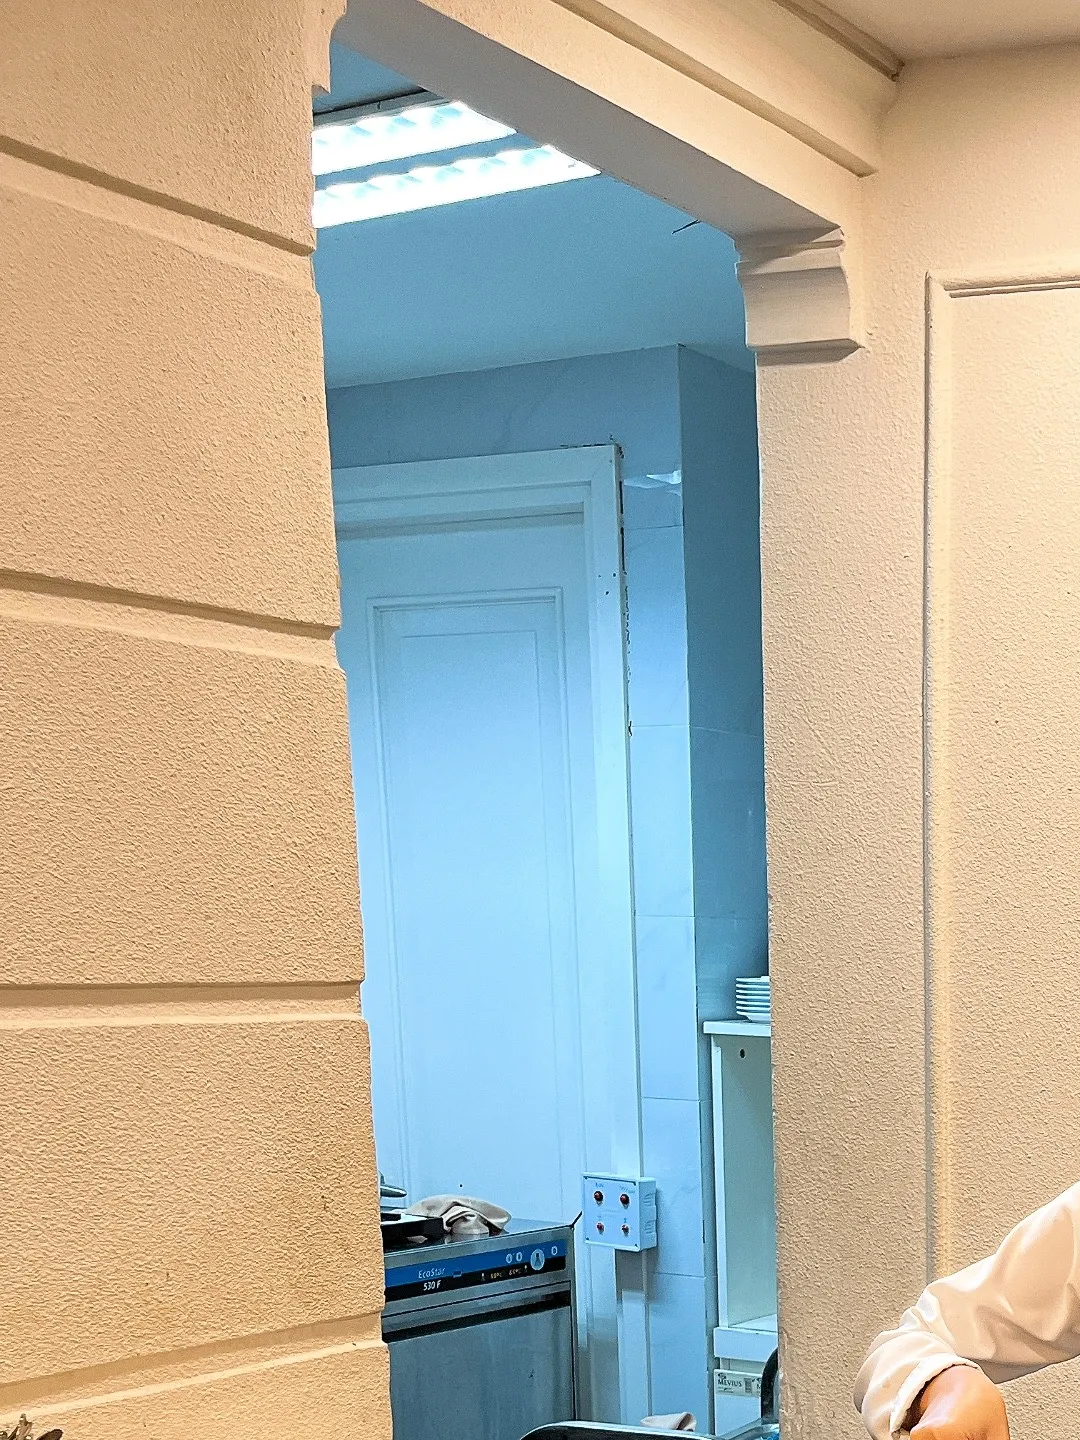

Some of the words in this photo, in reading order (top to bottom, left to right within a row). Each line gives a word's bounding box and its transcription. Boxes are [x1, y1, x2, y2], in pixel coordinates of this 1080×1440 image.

[418, 1267, 446, 1279] EcoStar
[423, 1281, 435, 1291] 530
[436, 1280, 442, 1289] F
[718, 1379, 742, 1387] MEVIUS
